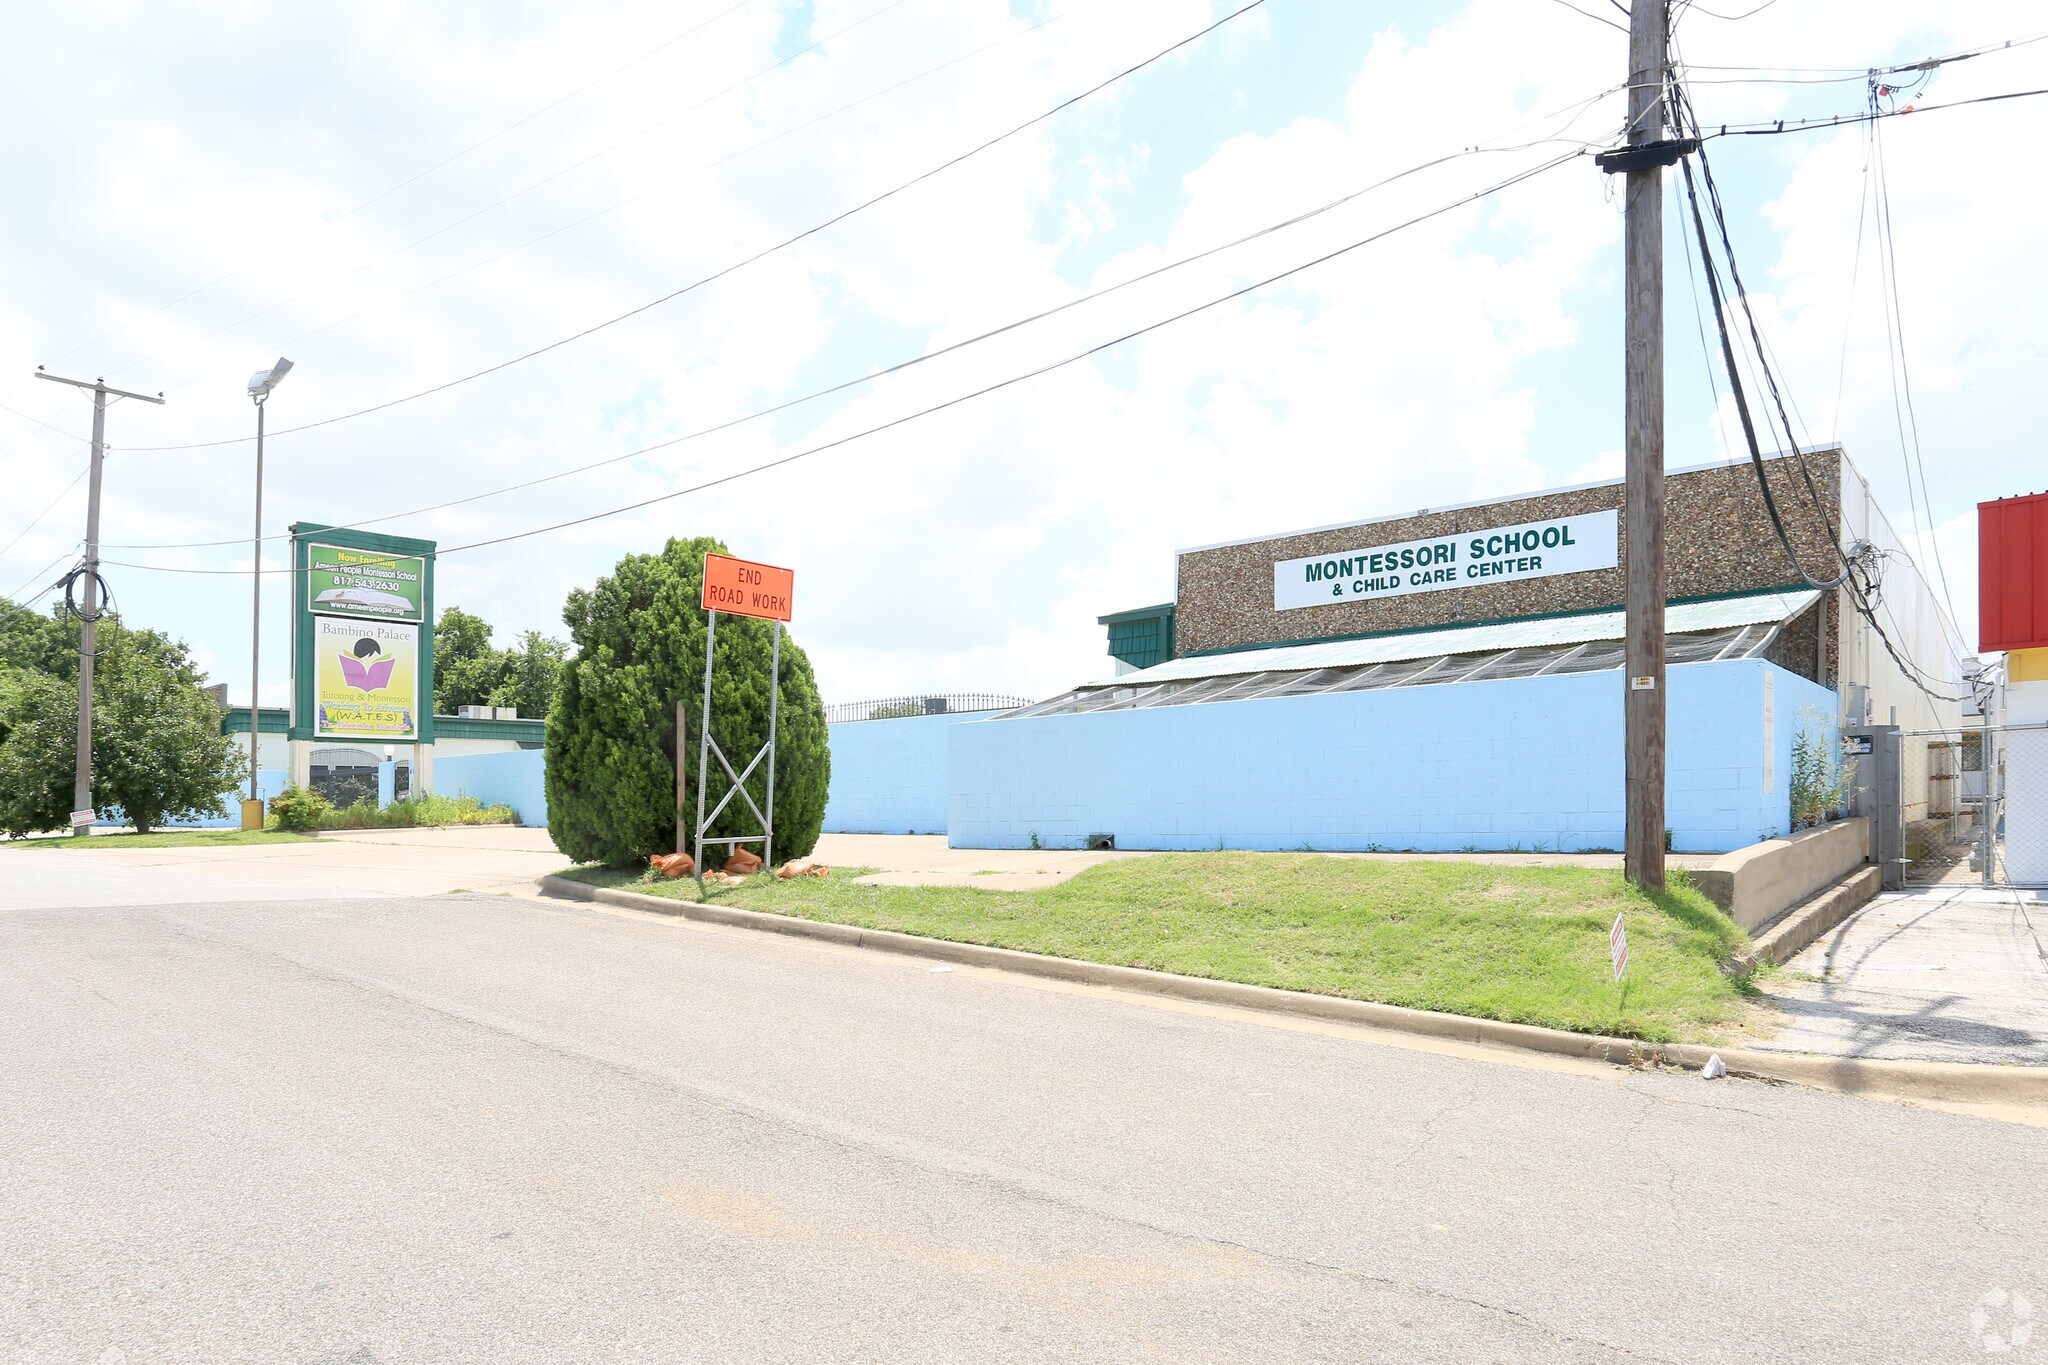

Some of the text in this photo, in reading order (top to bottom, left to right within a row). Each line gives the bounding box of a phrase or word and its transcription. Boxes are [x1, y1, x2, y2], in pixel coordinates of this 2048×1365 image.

[338, 552, 396, 569] Now Enrolling
[1305, 524, 1576, 583] MONTESSORI SCHOOL
[340, 565, 362, 576] People
[363, 567, 395, 578] Montessori
[396, 571, 417, 581] School
[738, 567, 761, 585] END
[1332, 555, 1543, 597] & CHILD CARE CENTER
[333, 576, 399, 591] 817.543.2630
[709, 585, 786, 612] ROAD WORK
[322, 623, 411, 641] Bambino Palace
[322, 691, 354, 702] Tutoring
[368, 693, 411, 703] Montessori
